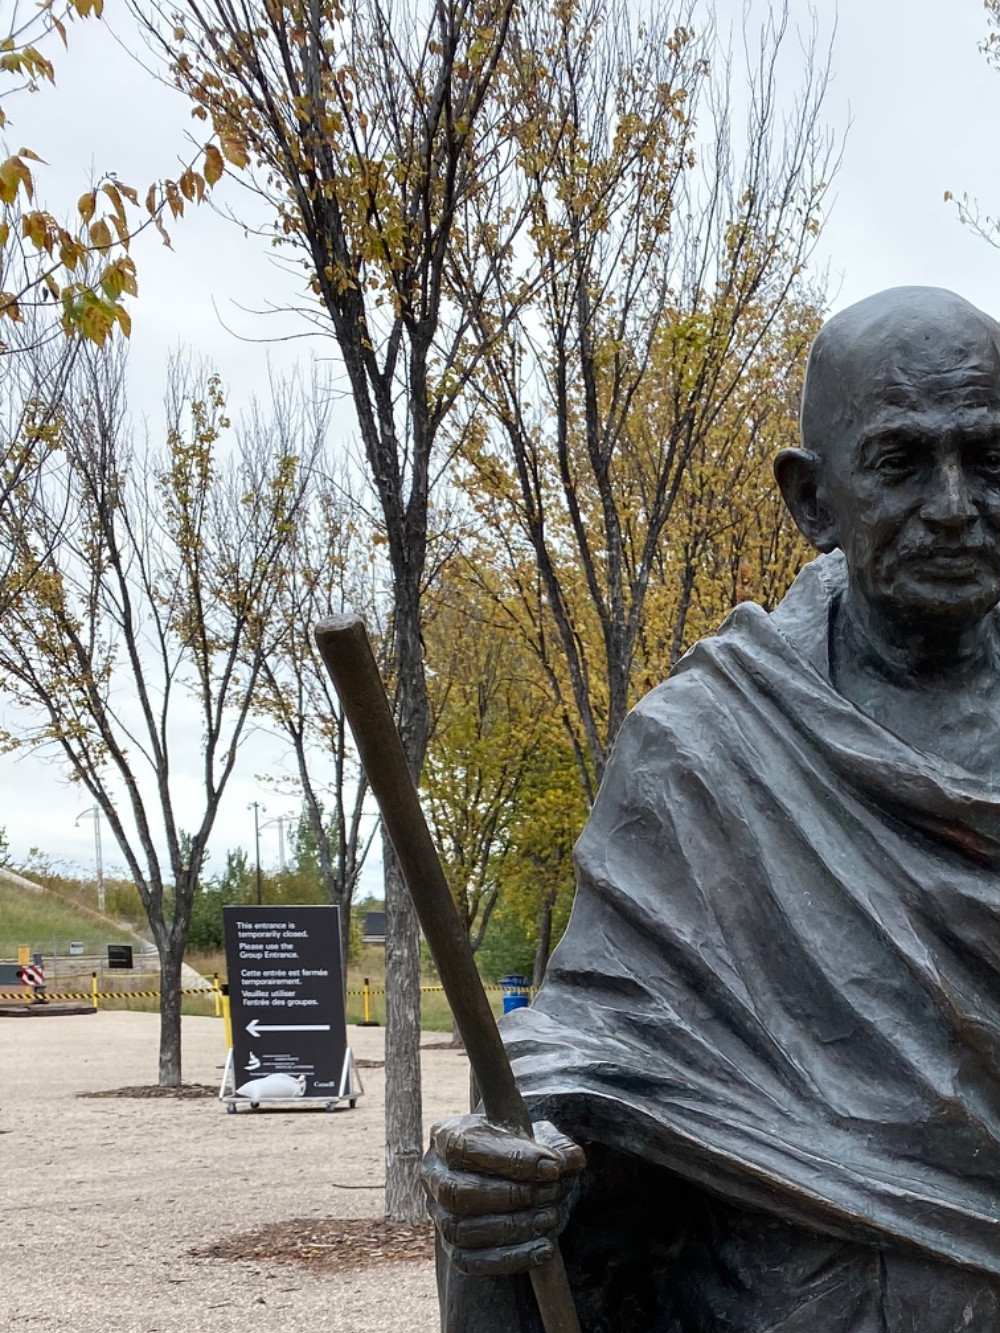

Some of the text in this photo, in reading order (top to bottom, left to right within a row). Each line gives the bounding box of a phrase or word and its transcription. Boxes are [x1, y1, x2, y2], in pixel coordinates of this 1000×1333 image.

[282, 930, 308, 938] closed.
[239, 951, 263, 959] Group
[241, 978, 302, 986] temporairement.
[271, 989, 296, 997] utiliser
[286, 999, 319, 1007] groupes.
